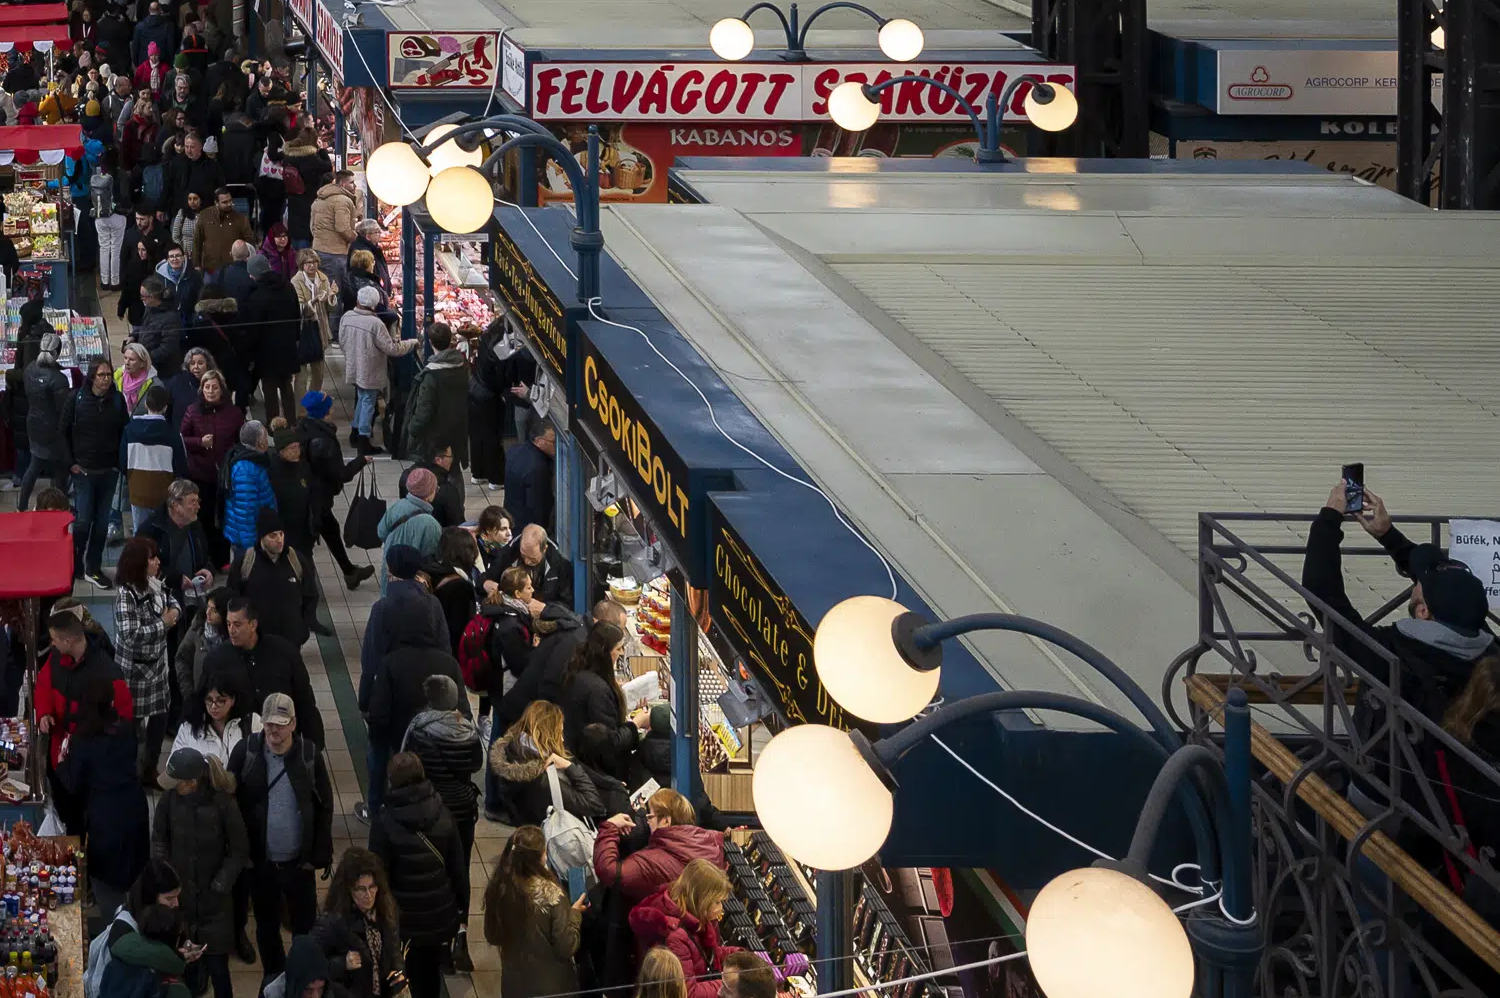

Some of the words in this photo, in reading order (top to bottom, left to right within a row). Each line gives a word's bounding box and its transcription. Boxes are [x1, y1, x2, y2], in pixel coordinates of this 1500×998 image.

[1305, 77, 1369, 87] AGROCORP
[536, 65, 795, 115] FELVÁGOTT
[1235, 87, 1285, 97] AGROCORP
[670, 128, 794, 147] KABANOS
[1456, 535, 1490, 546] Büfék,
[715, 544, 789, 666] Chocolate
